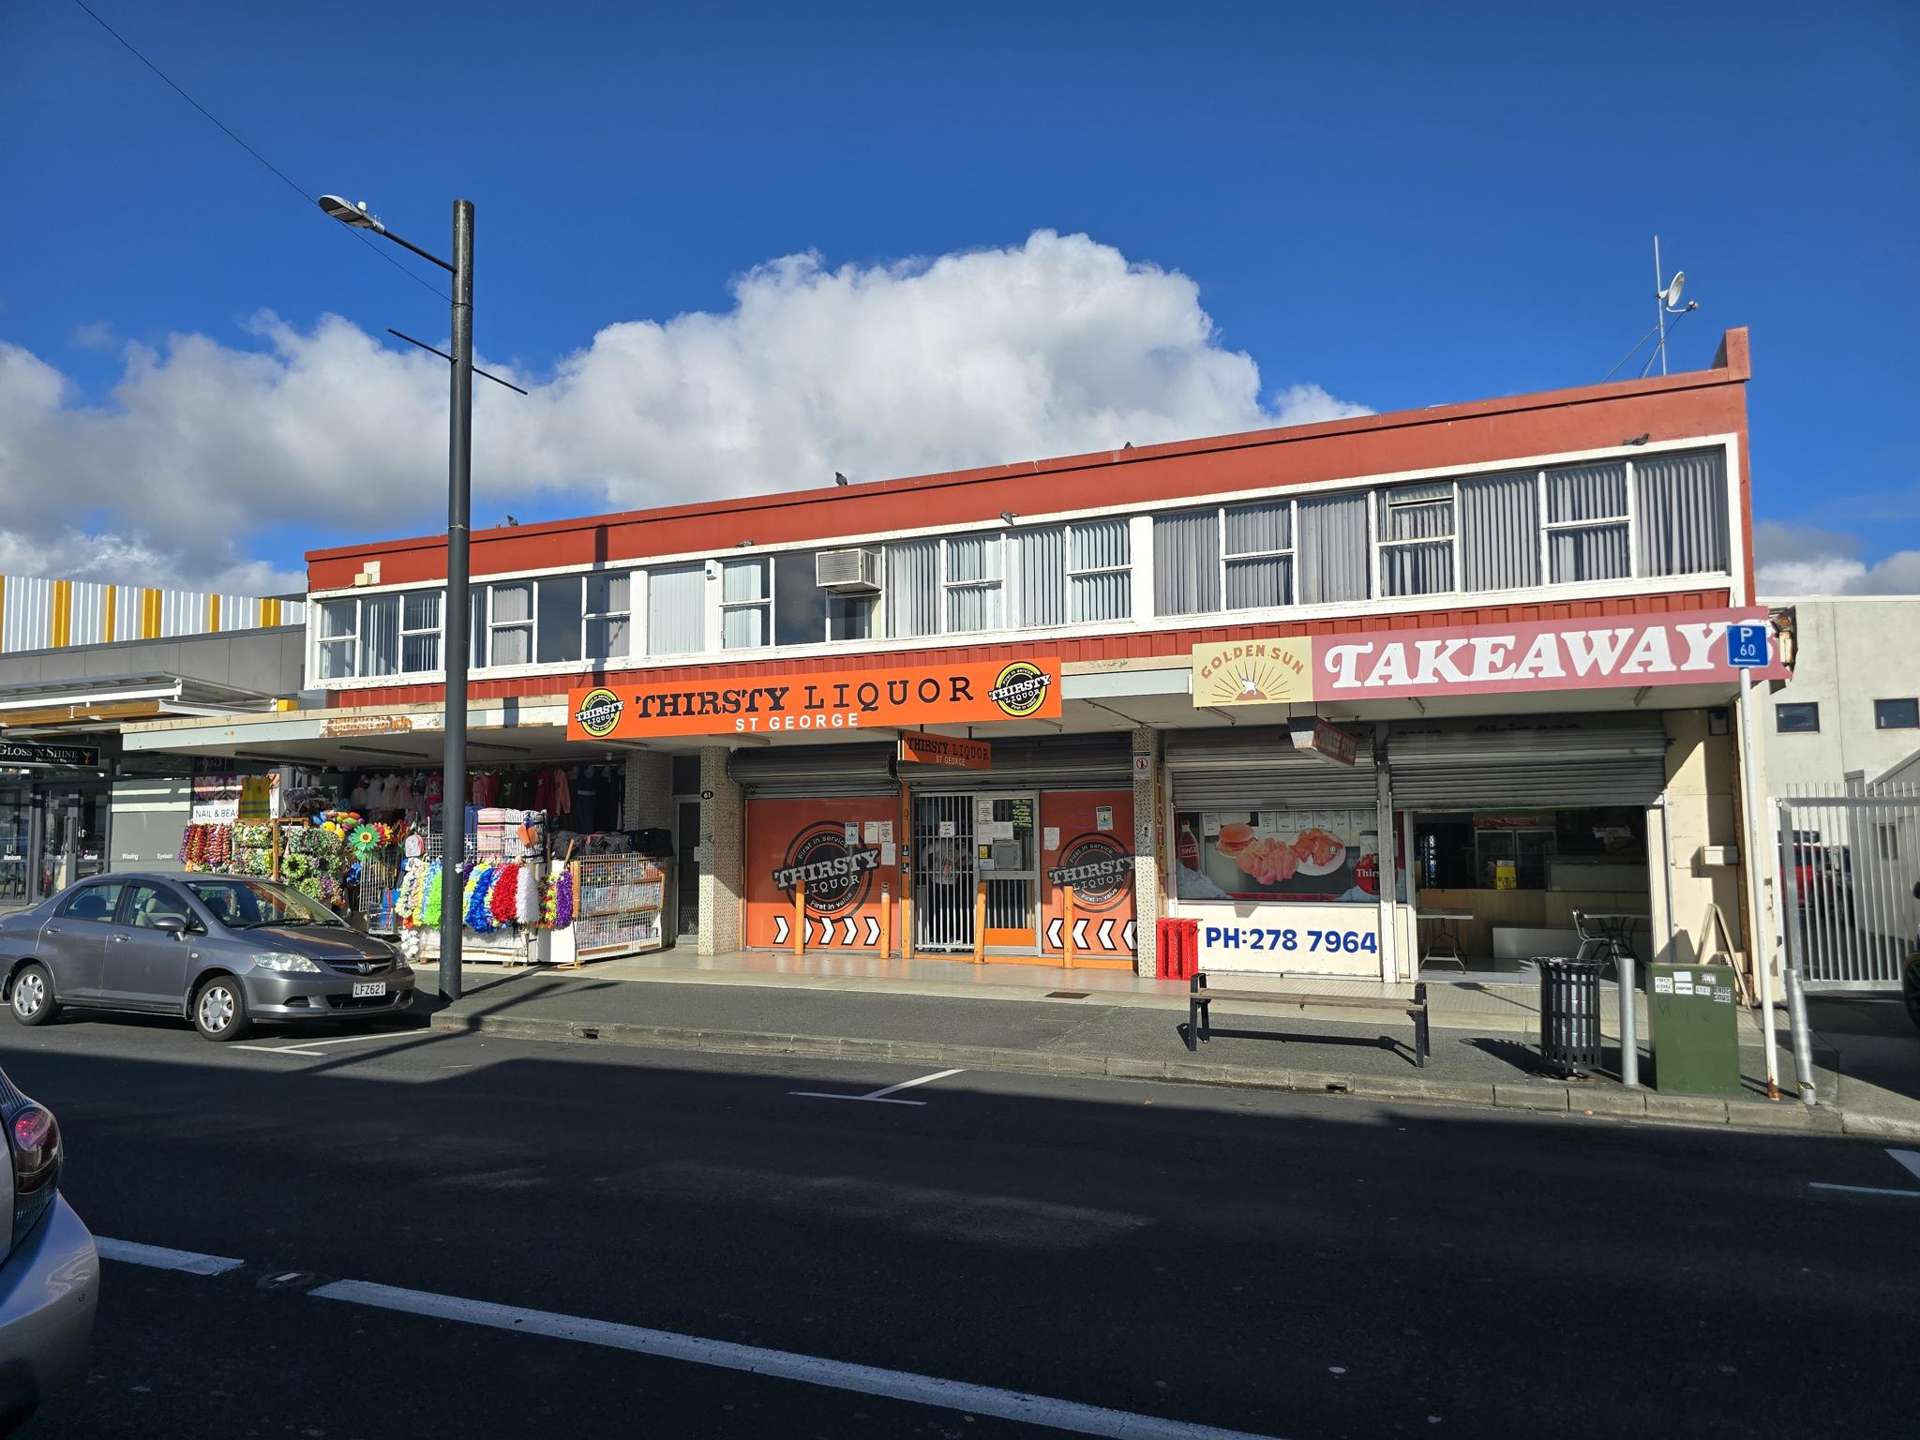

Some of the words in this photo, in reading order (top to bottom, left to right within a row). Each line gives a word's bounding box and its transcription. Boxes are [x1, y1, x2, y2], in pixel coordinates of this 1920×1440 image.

[1740, 627, 1753, 642] P
[1740, 644, 1755, 656] 60
[1200, 644, 1266, 679] GOLDEN
[1270, 647, 1304, 675] SUN
[635, 686, 790, 718] THIRSTY
[804, 676, 974, 712] LIQUOR
[989, 674, 1050, 701] THIRSTY
[1005, 689, 1040, 704] LIQUOR
[576, 701, 624, 722] THIRSTY
[736, 717, 759, 732] ST
[769, 713, 859, 730] GEORGE
[906, 736, 949, 755] THIRSTY
[952, 743, 989, 760] LIQUOR
[195, 809, 212, 818] NAIL
[214, 809, 219, 818] &
[220, 808, 238, 817] BEA
[798, 843, 813, 861] First
[773, 849, 880, 888] THIRSTY
[1072, 874, 1123, 891] LIQUOR
[810, 900, 827, 910] First
[836, 892, 853, 908] value
[1206, 927, 1298, 951] PH:278
[1307, 930, 1377, 954] 7964
